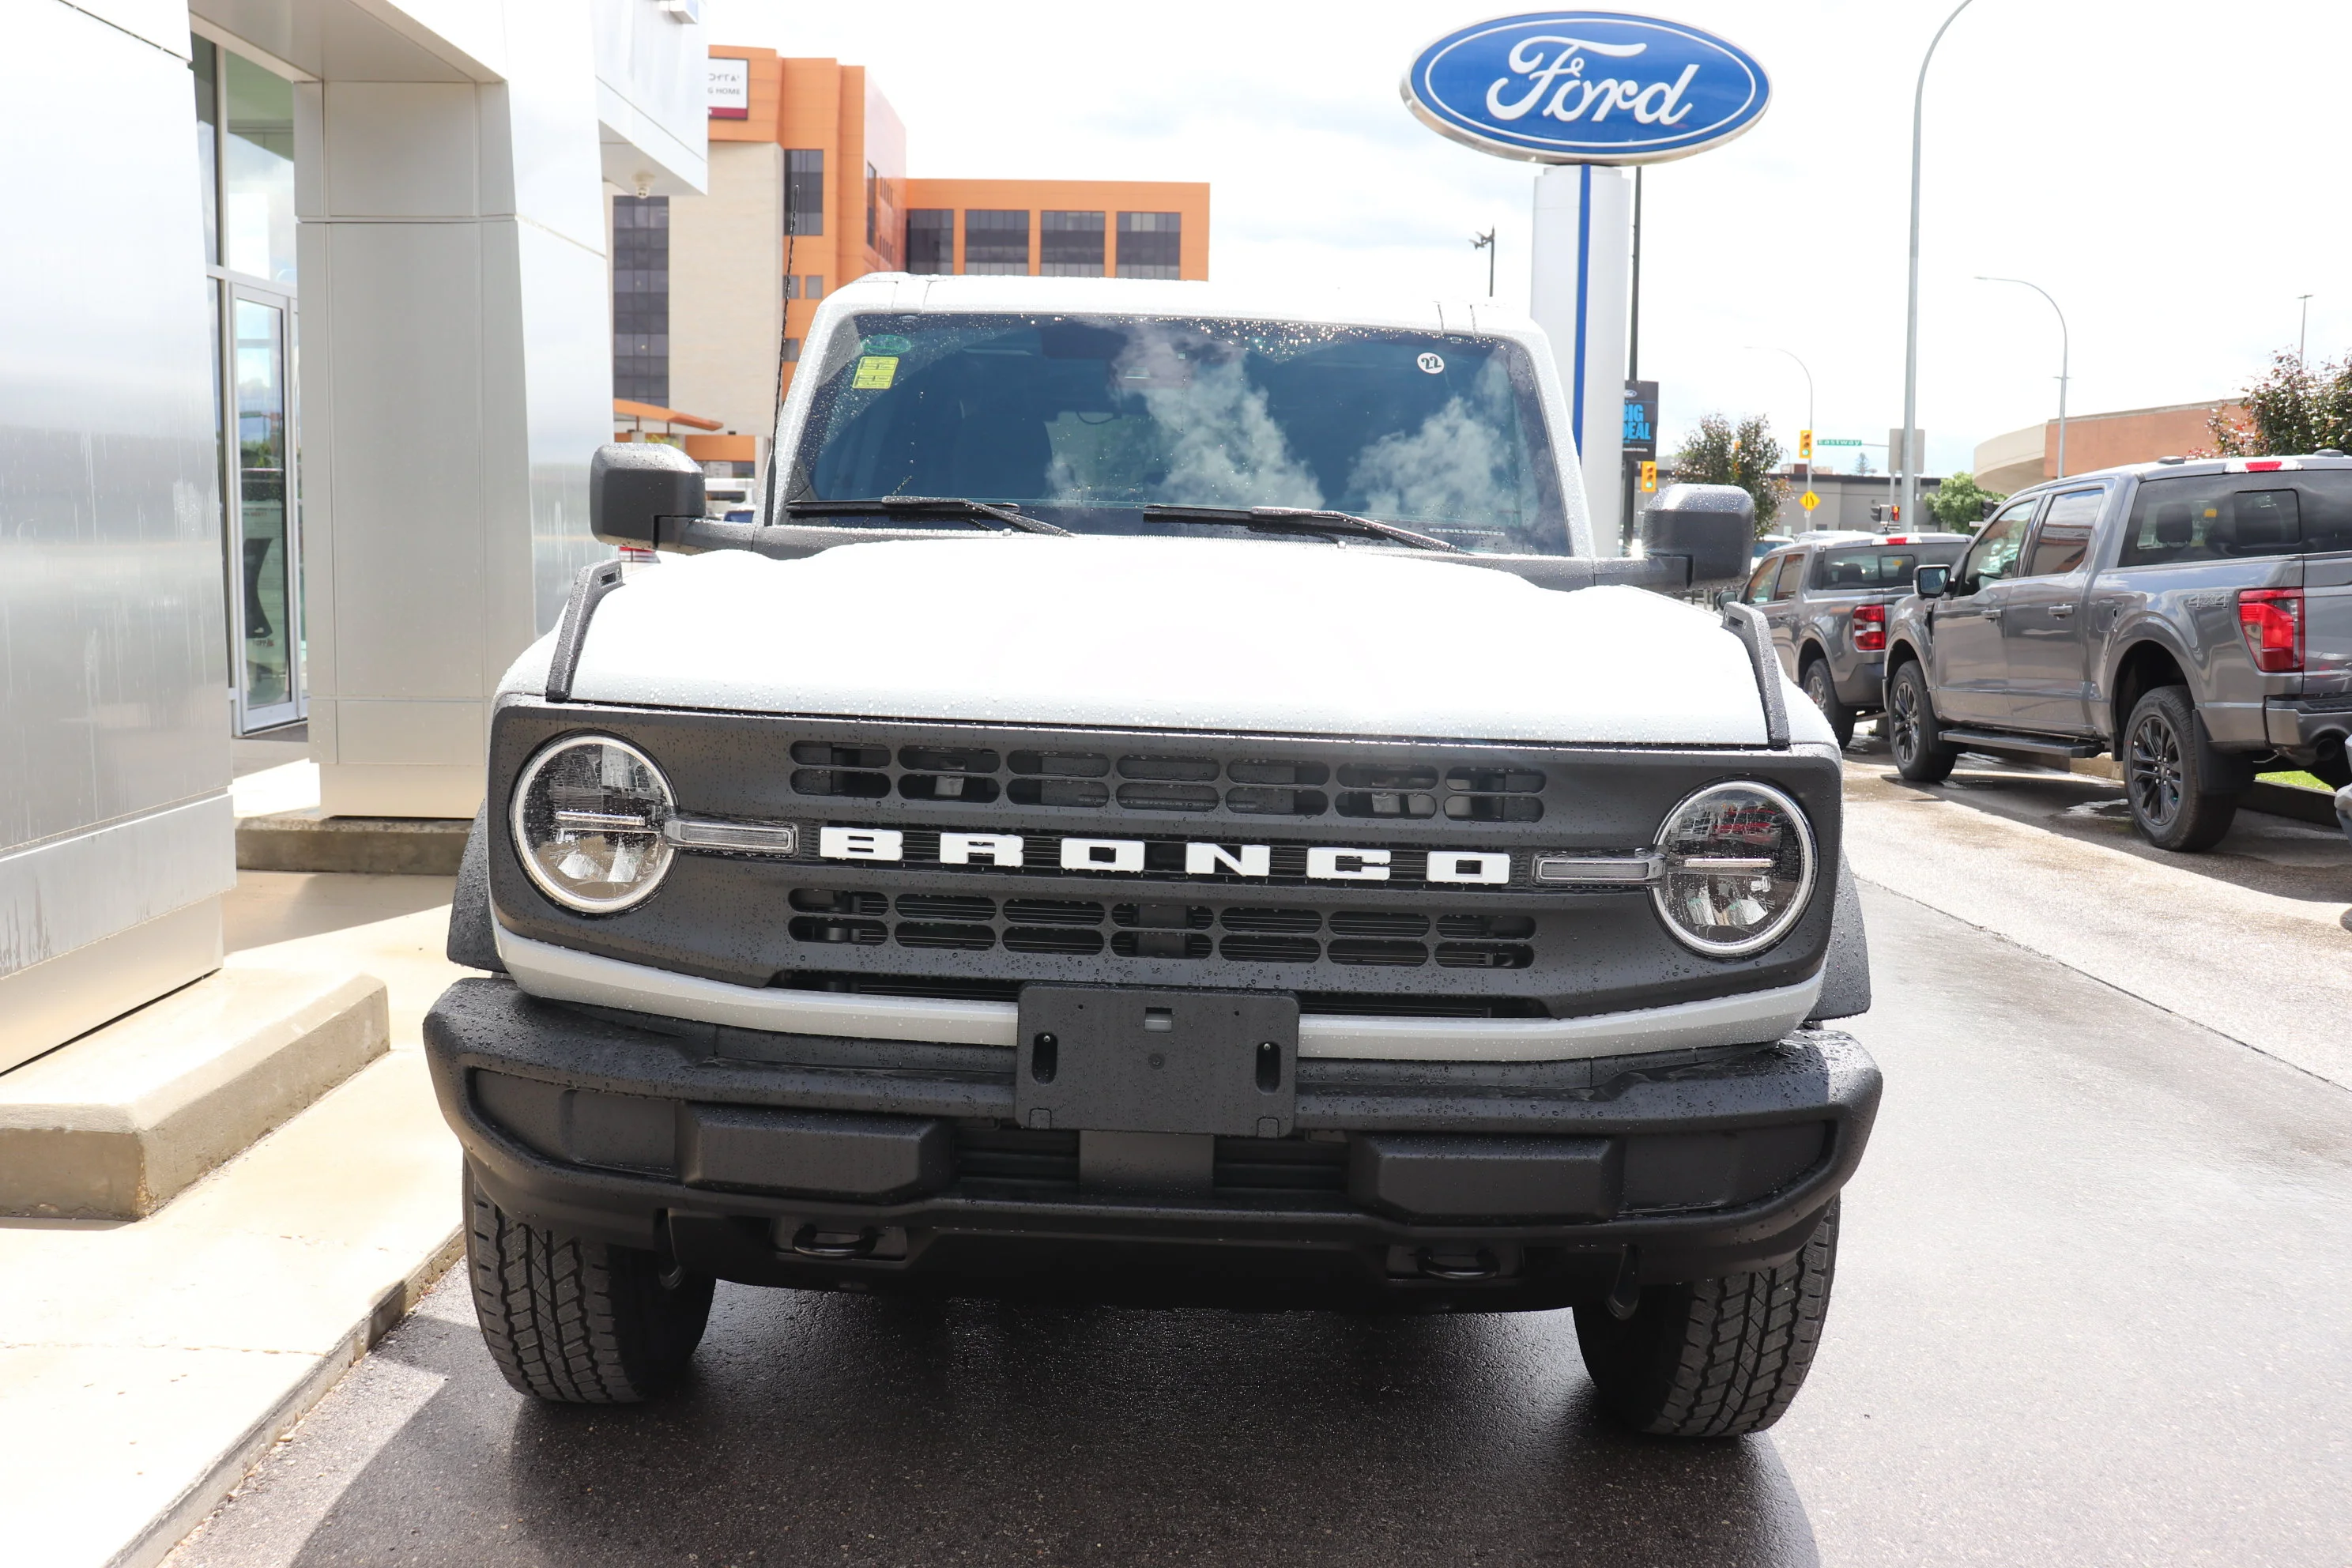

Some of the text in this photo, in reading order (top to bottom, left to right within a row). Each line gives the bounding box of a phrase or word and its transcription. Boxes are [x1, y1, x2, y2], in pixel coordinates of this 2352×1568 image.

[1486, 35, 1700, 125] Ford
[1421, 356, 1442, 370] 22
[820, 826, 1510, 884] BRONCO
